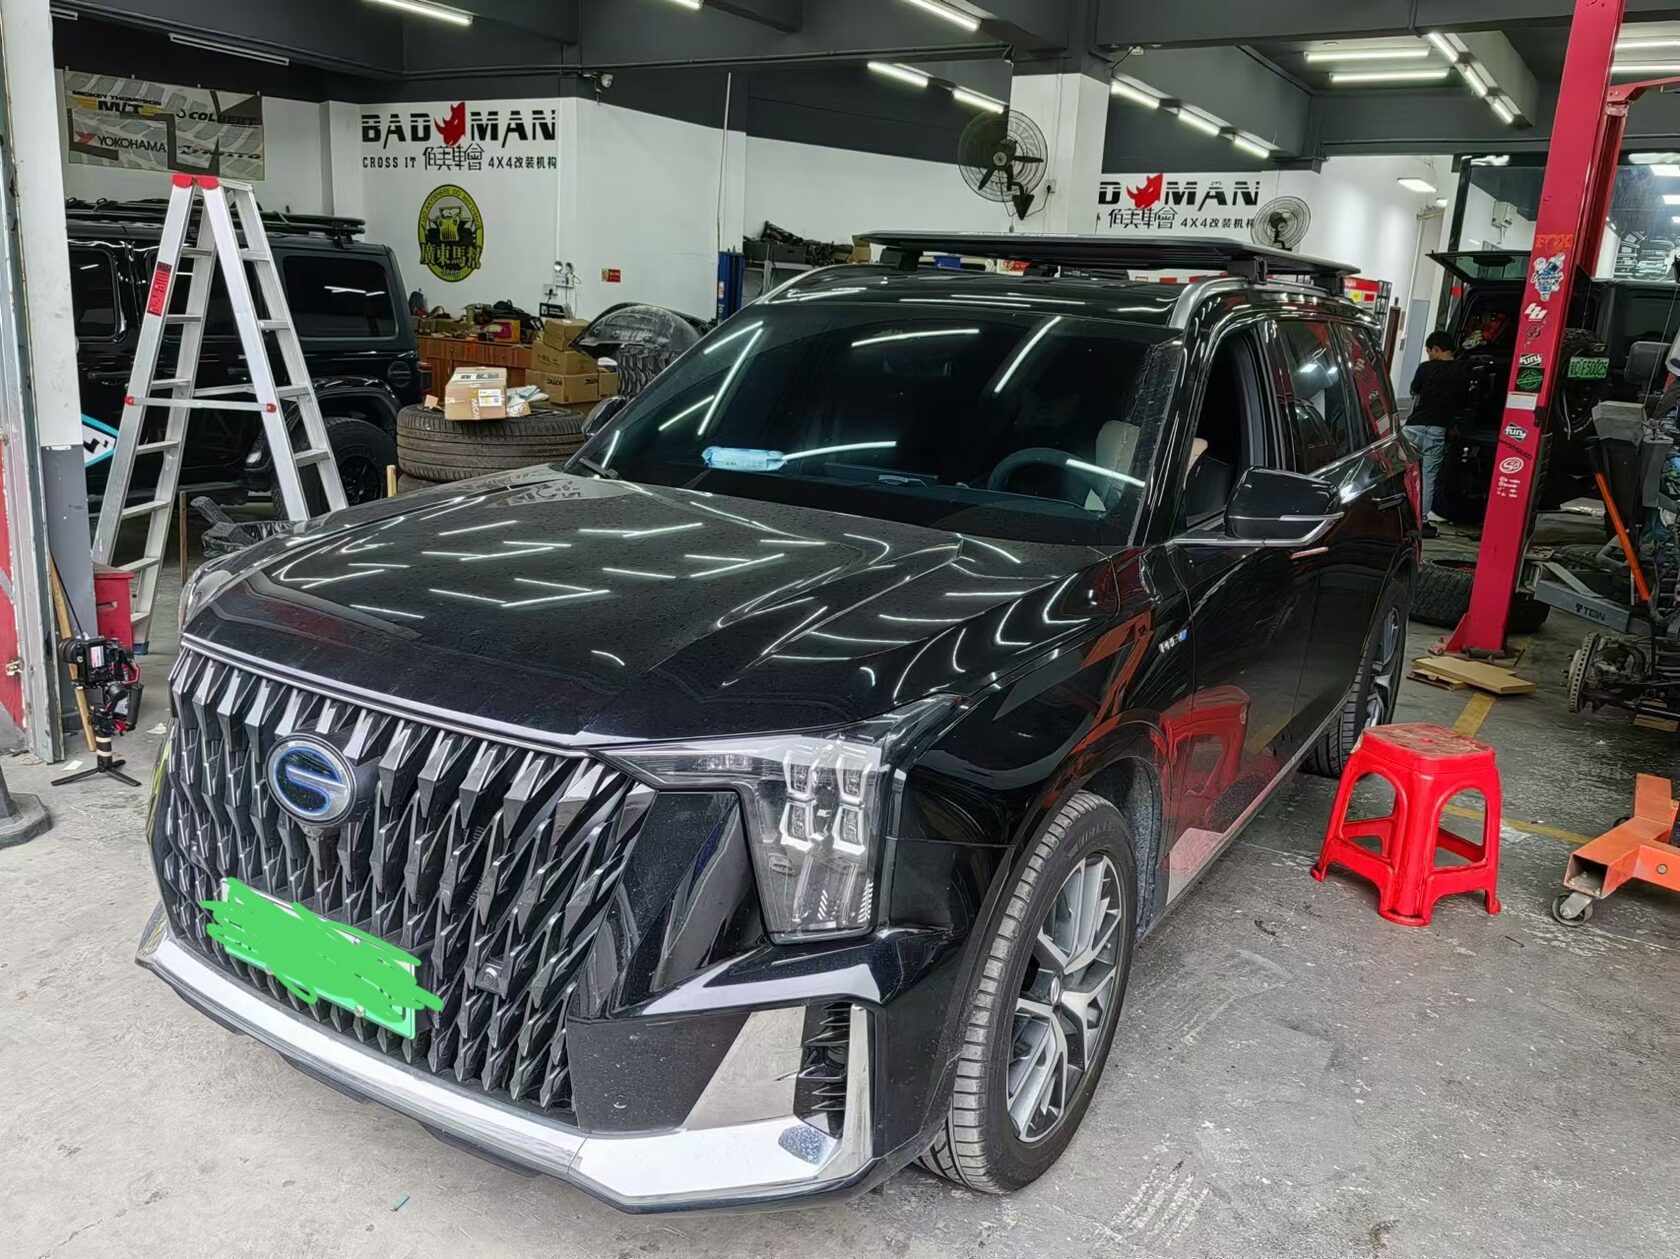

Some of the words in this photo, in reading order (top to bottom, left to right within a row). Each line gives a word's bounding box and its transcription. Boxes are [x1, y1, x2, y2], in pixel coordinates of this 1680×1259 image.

[361, 113, 431, 149] BAD
[470, 110, 556, 149] MAN
[97, 135, 167, 152] YOKOHAMA
[362, 156, 398, 169] CROSS
[405, 156, 417, 169] IT
[488, 156, 557, 169] 4X4改装机构
[1164, 181, 1261, 212] MAN
